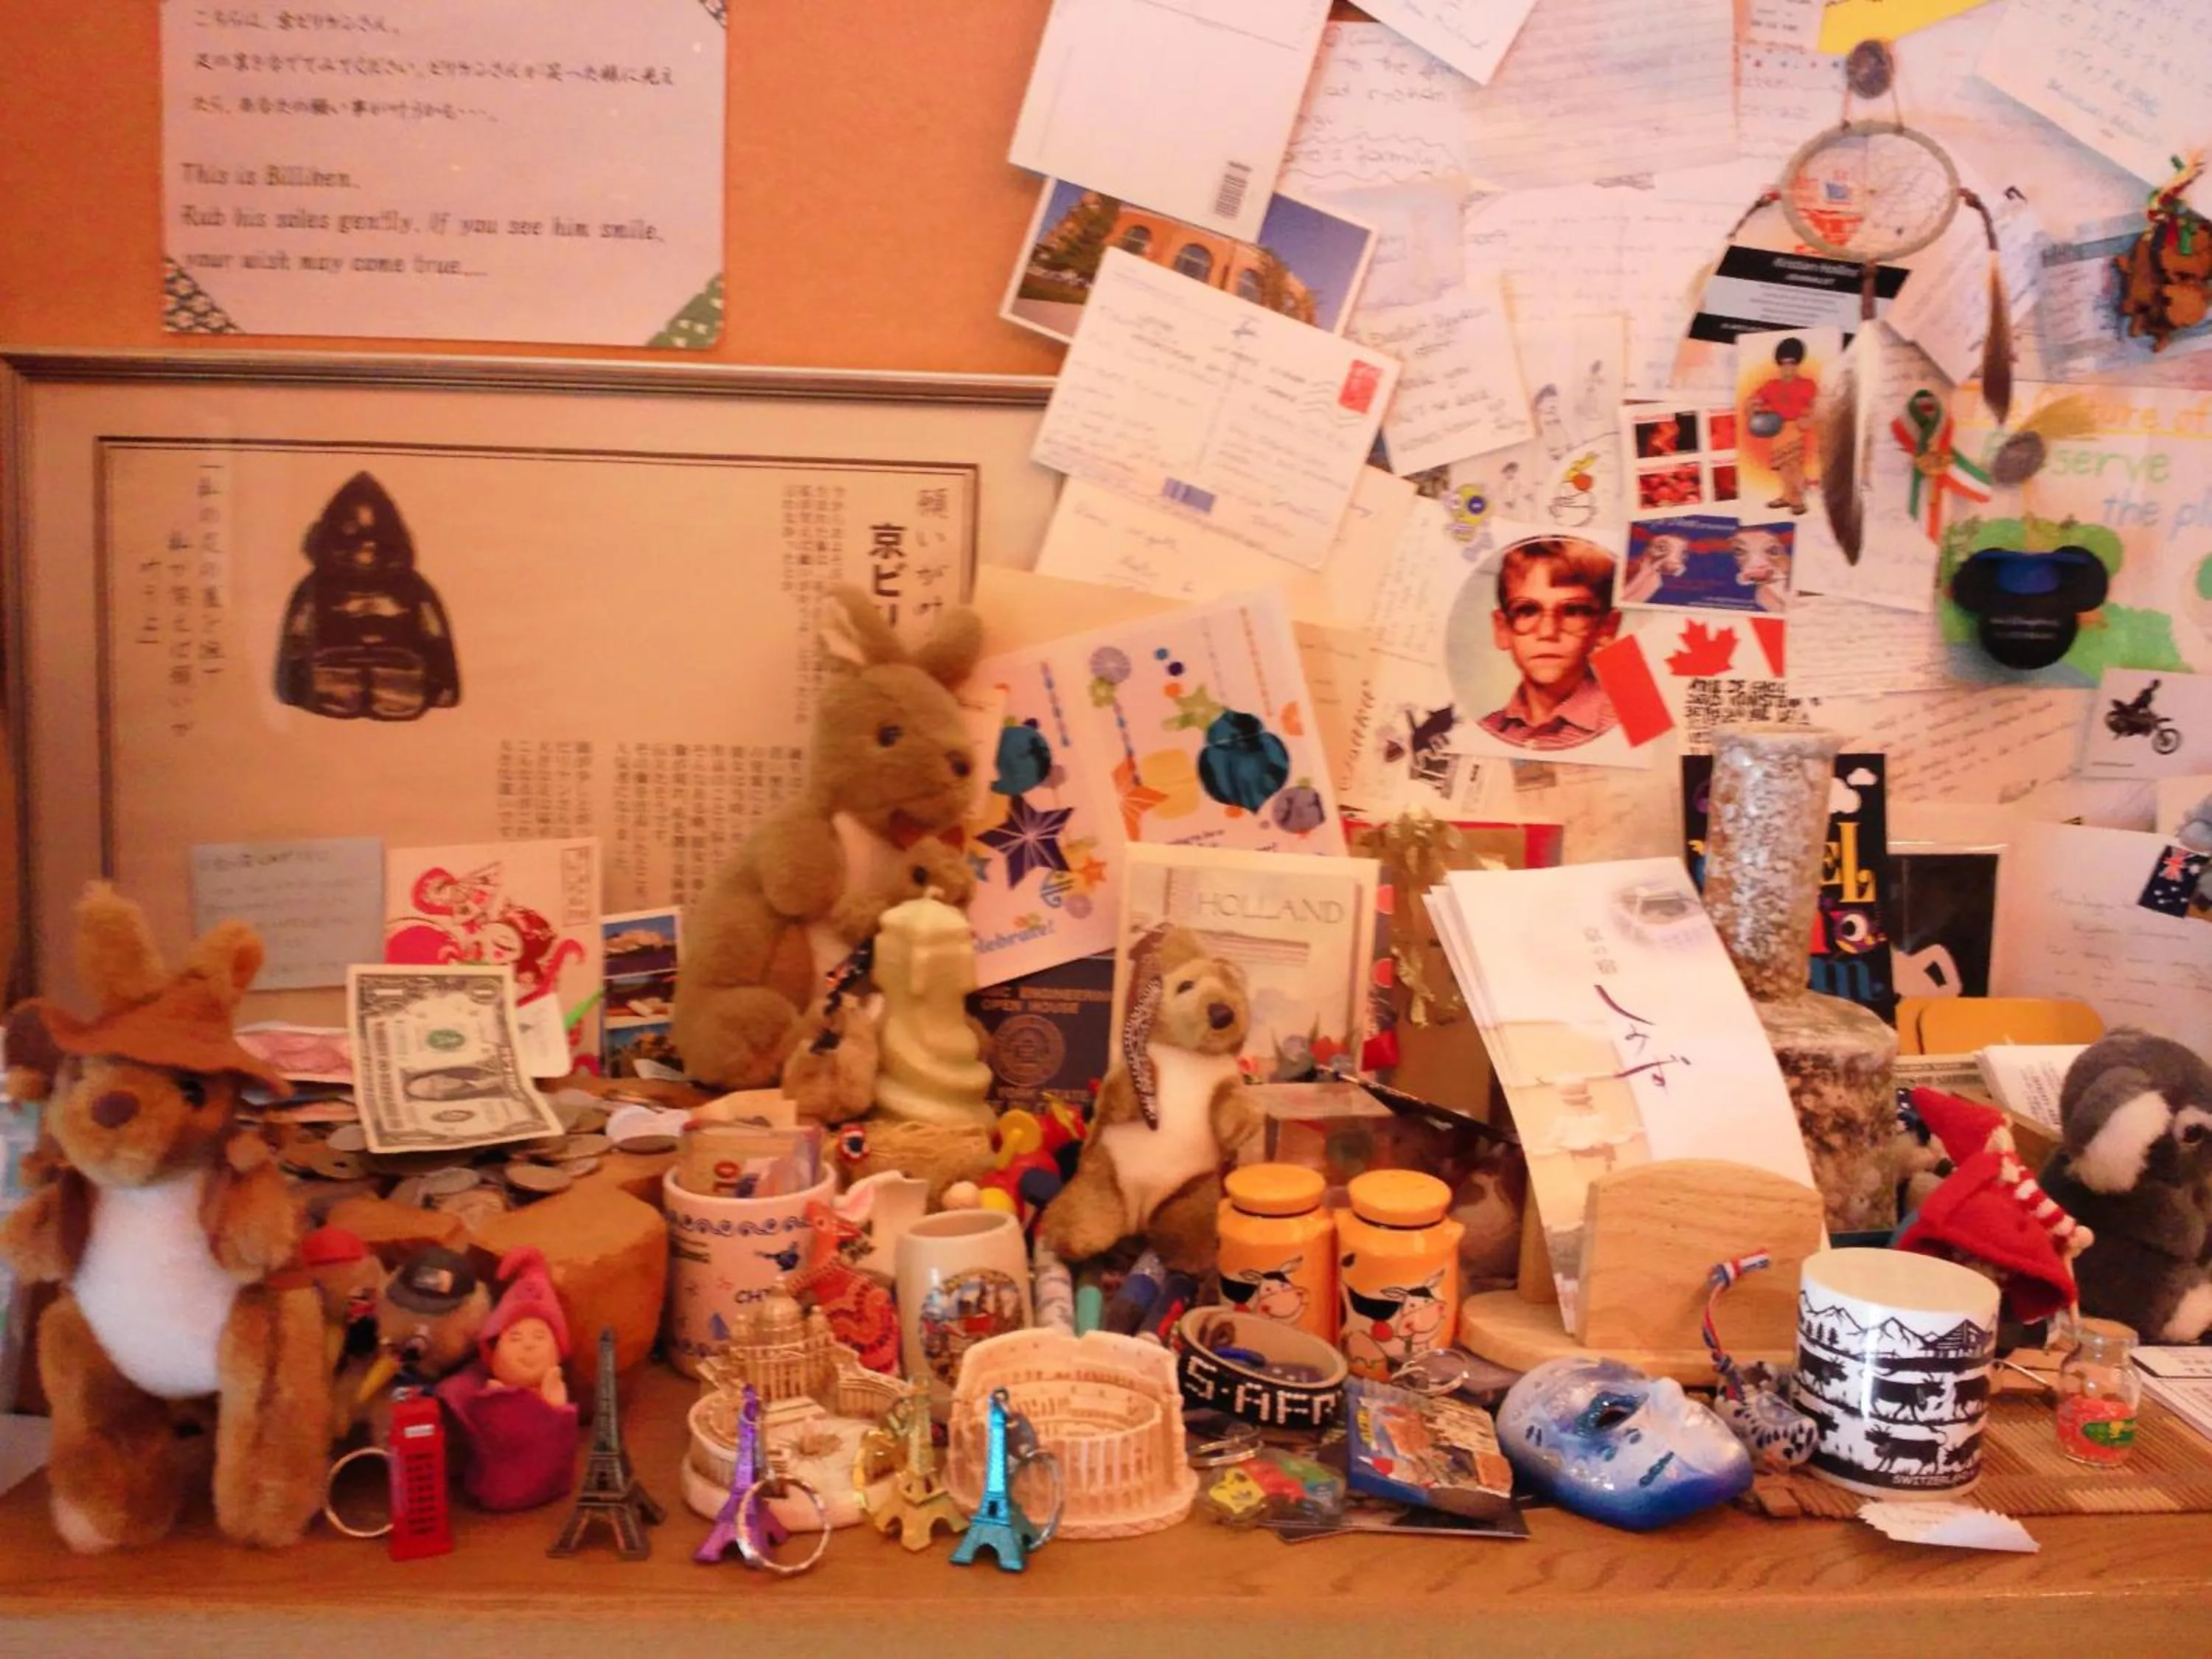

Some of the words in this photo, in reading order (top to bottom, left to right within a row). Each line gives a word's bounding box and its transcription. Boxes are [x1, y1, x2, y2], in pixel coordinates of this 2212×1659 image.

[181, 162, 228, 185] This
[234, 168, 257, 186] is
[181, 204, 225, 226] Rub
[233, 206, 266, 227] his
[274, 208, 330, 229] soles
[459, 218, 498, 237] you
[507, 220, 543, 236] see
[552, 216, 590, 237] him
[242, 250, 290, 271] wish
[298, 255, 344, 274] may
[351, 257, 405, 274] come
[2102, 488, 2160, 528] the
[1196, 891, 1346, 925] HOLLAND
